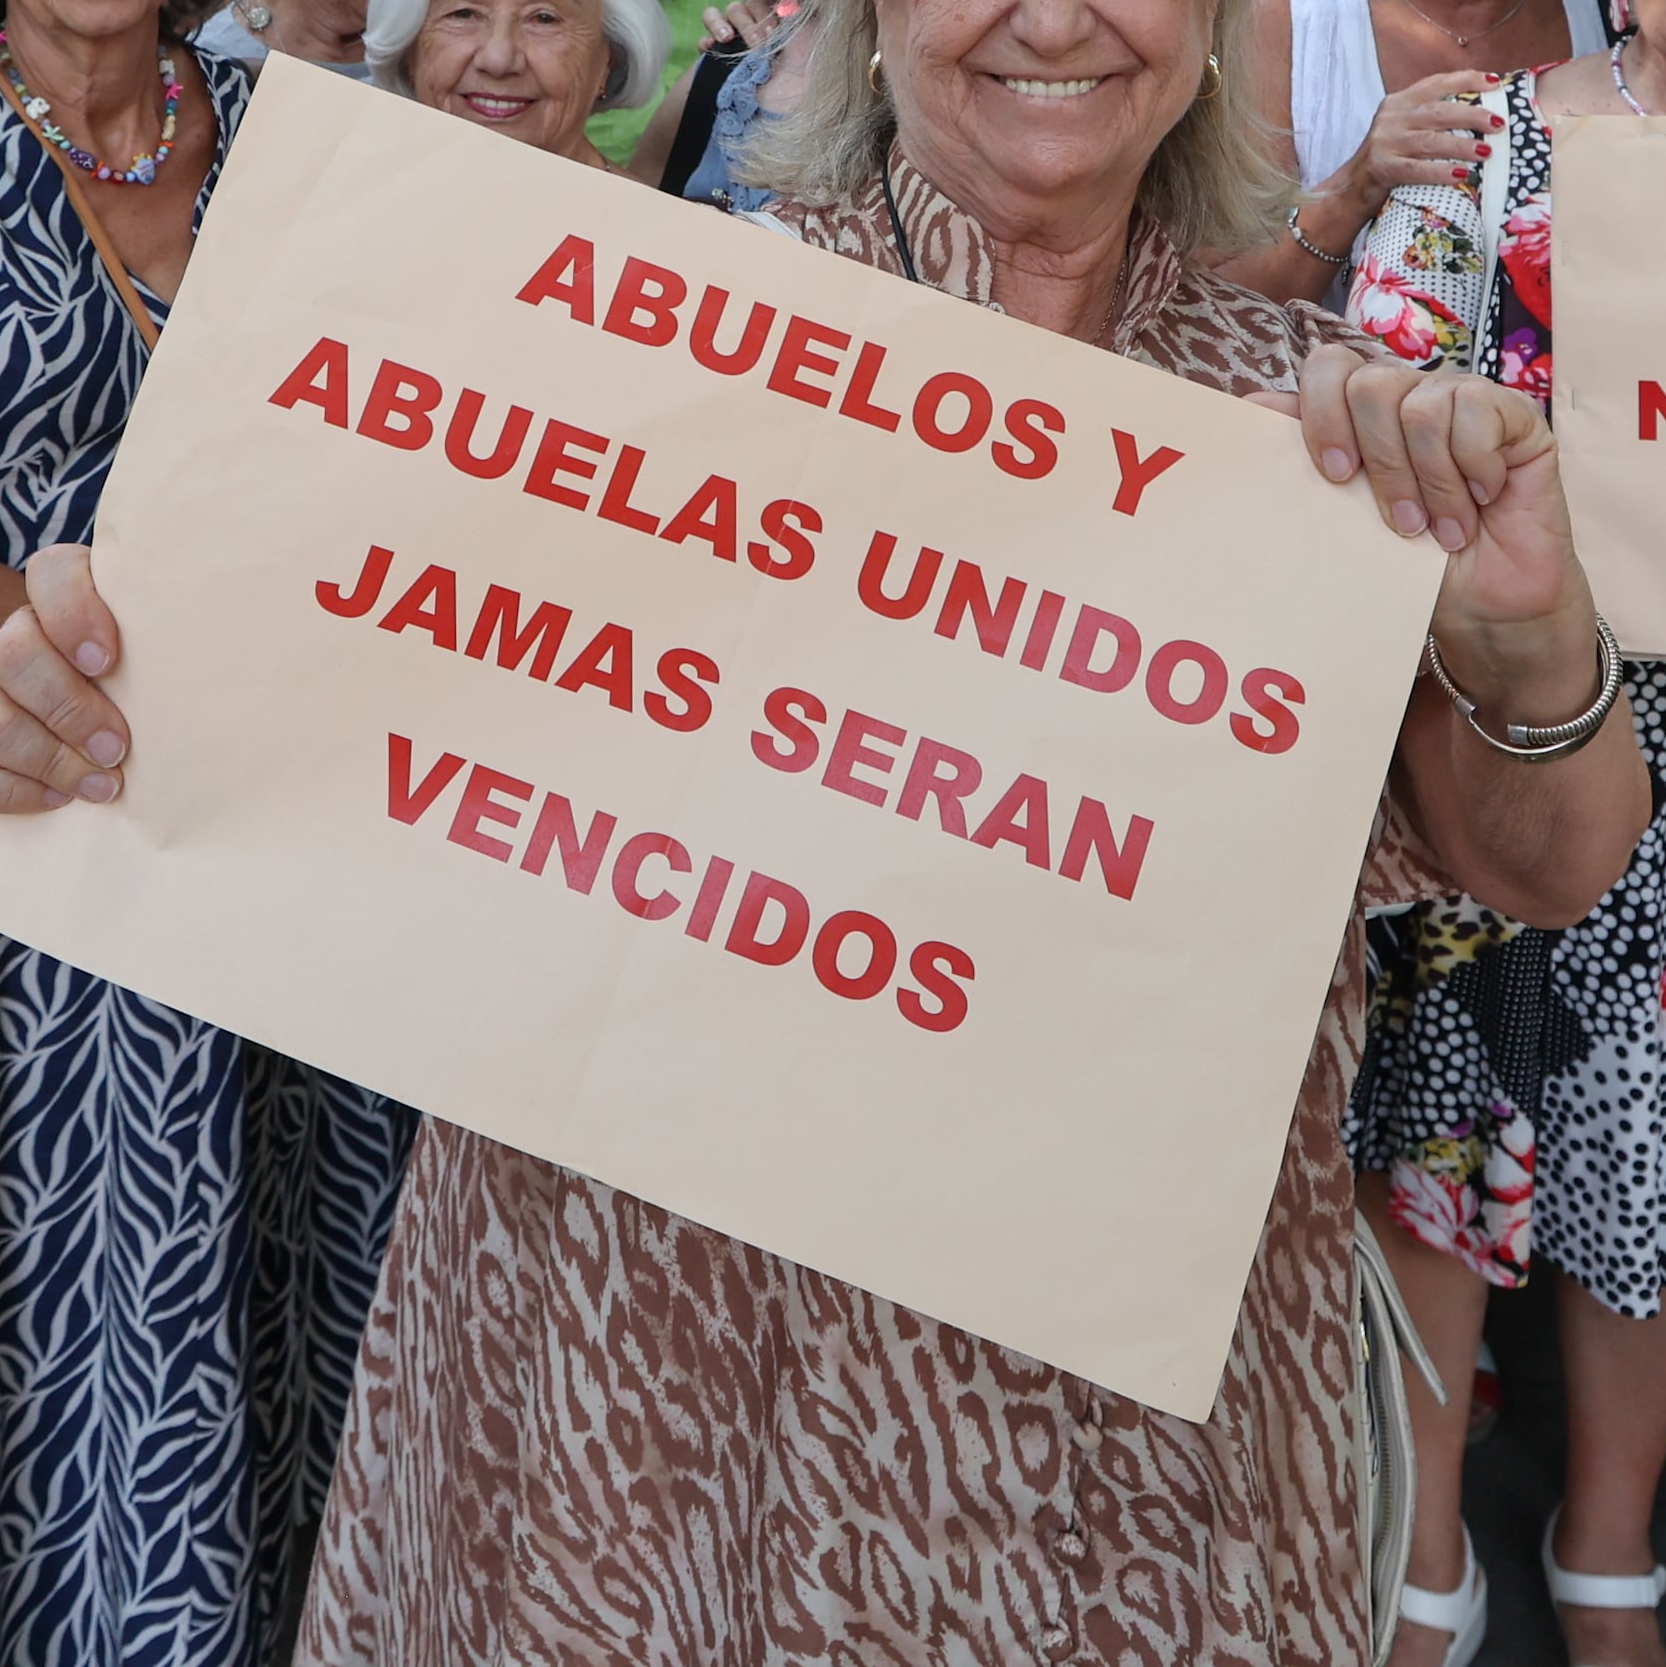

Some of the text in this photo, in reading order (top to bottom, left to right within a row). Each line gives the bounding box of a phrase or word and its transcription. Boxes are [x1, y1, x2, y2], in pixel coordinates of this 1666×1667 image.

[515, 234, 1185, 517] ABUELOS Y
[268, 336, 1306, 755] ABUELAS UNIDOS
[314, 544, 1155, 901] JAMAS SERAN
[387, 732, 976, 1034] VENCIDOS
